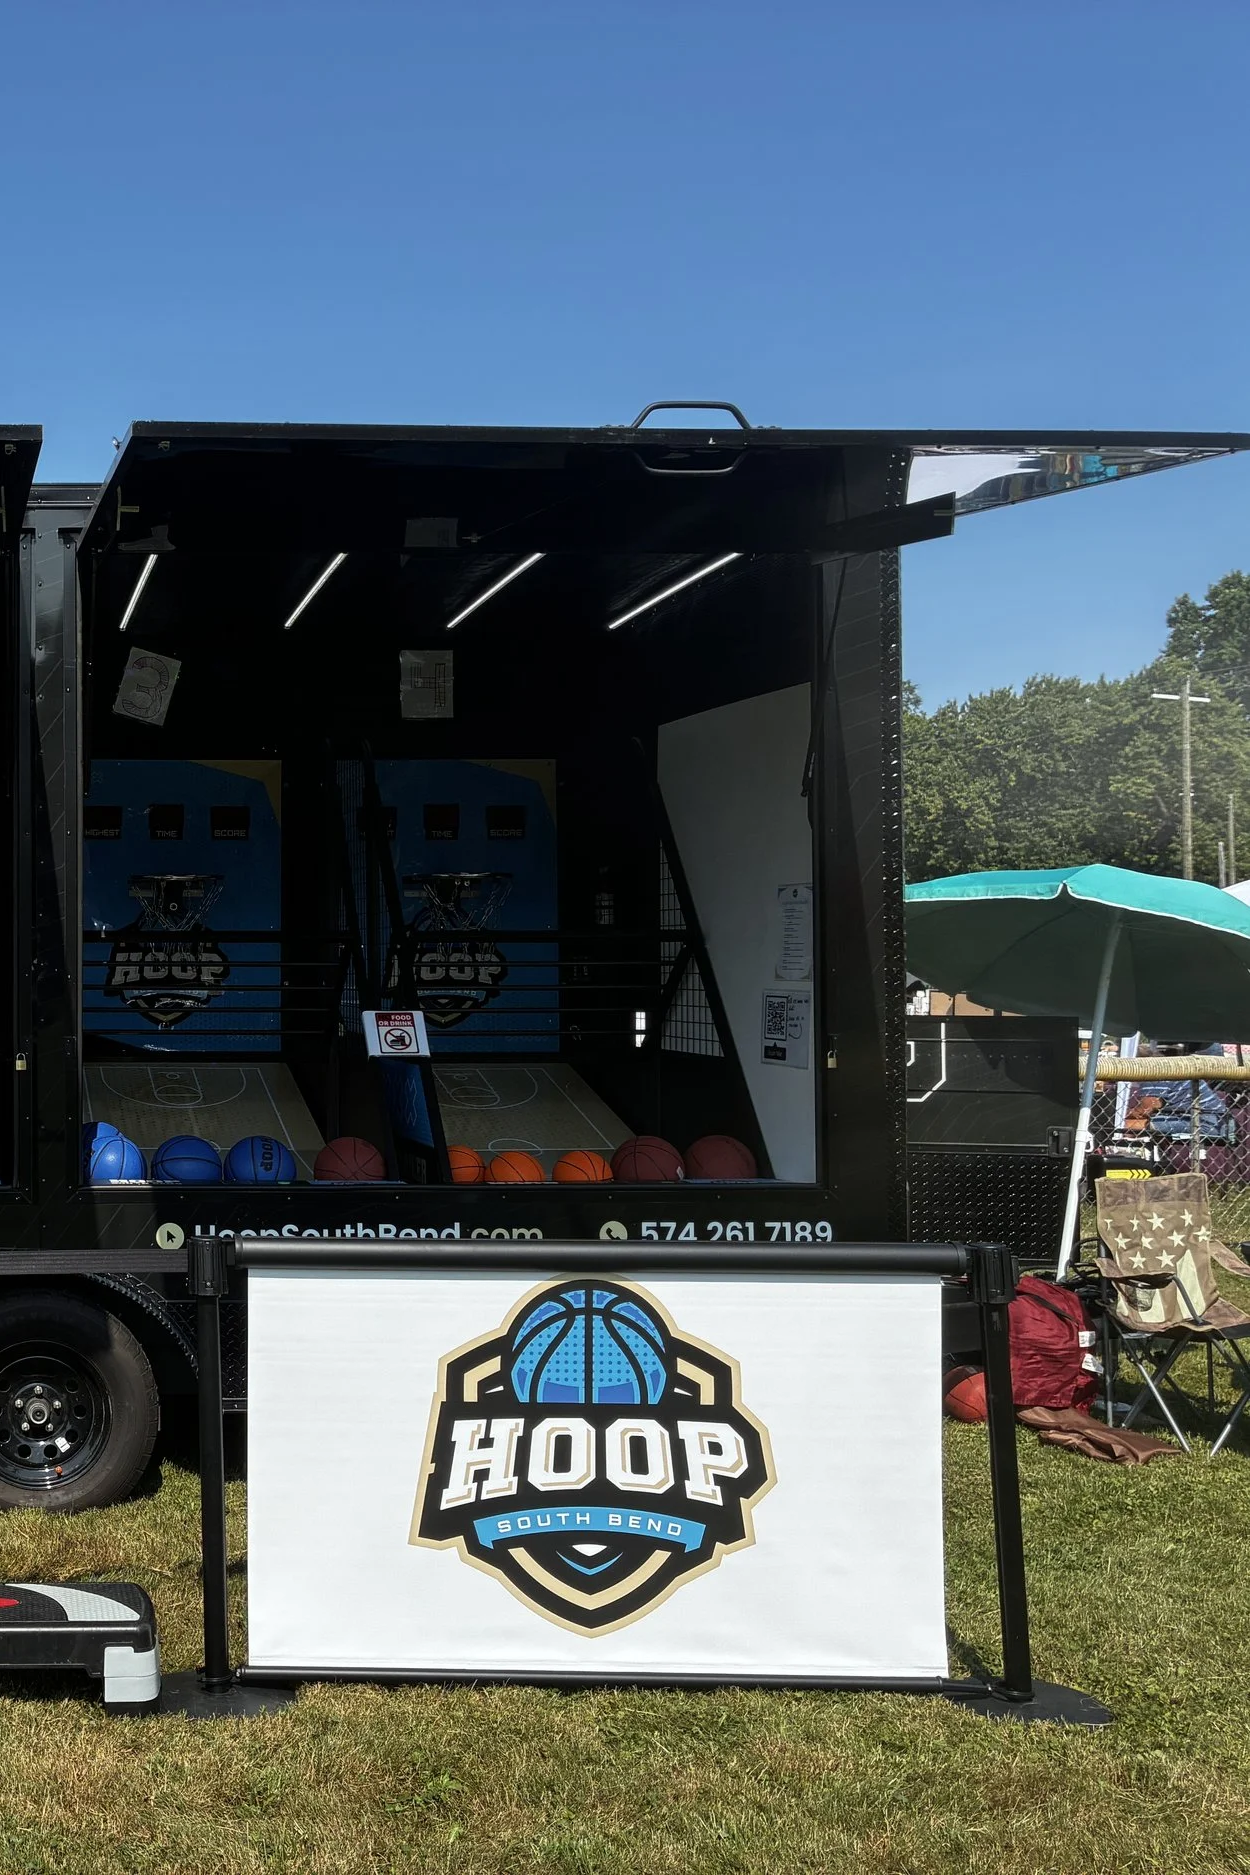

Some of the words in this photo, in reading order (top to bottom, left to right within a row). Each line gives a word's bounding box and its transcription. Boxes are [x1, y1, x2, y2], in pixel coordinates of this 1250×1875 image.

[121, 655, 170, 719] 3
[409, 662, 447, 708] 4
[85, 828, 121, 837] HIGHEST
[155, 829, 178, 838] TIME
[213, 829, 247, 837] SCORE
[431, 830, 454, 838] TIME
[489, 828, 523, 837] SCORE
[111, 951, 225, 986] HOOP
[413, 952, 502, 985] OOP
[195, 1222, 543, 1240] HSouthBendcom
[641, 1221, 698, 1241] 574
[706, 1221, 755, 1242] 261
[764, 1221, 833, 1242] 7189
[440, 1418, 748, 1510] HOOP
[497, 1512, 591, 1534] SOUTH
[608, 1512, 683, 1537] BEND
